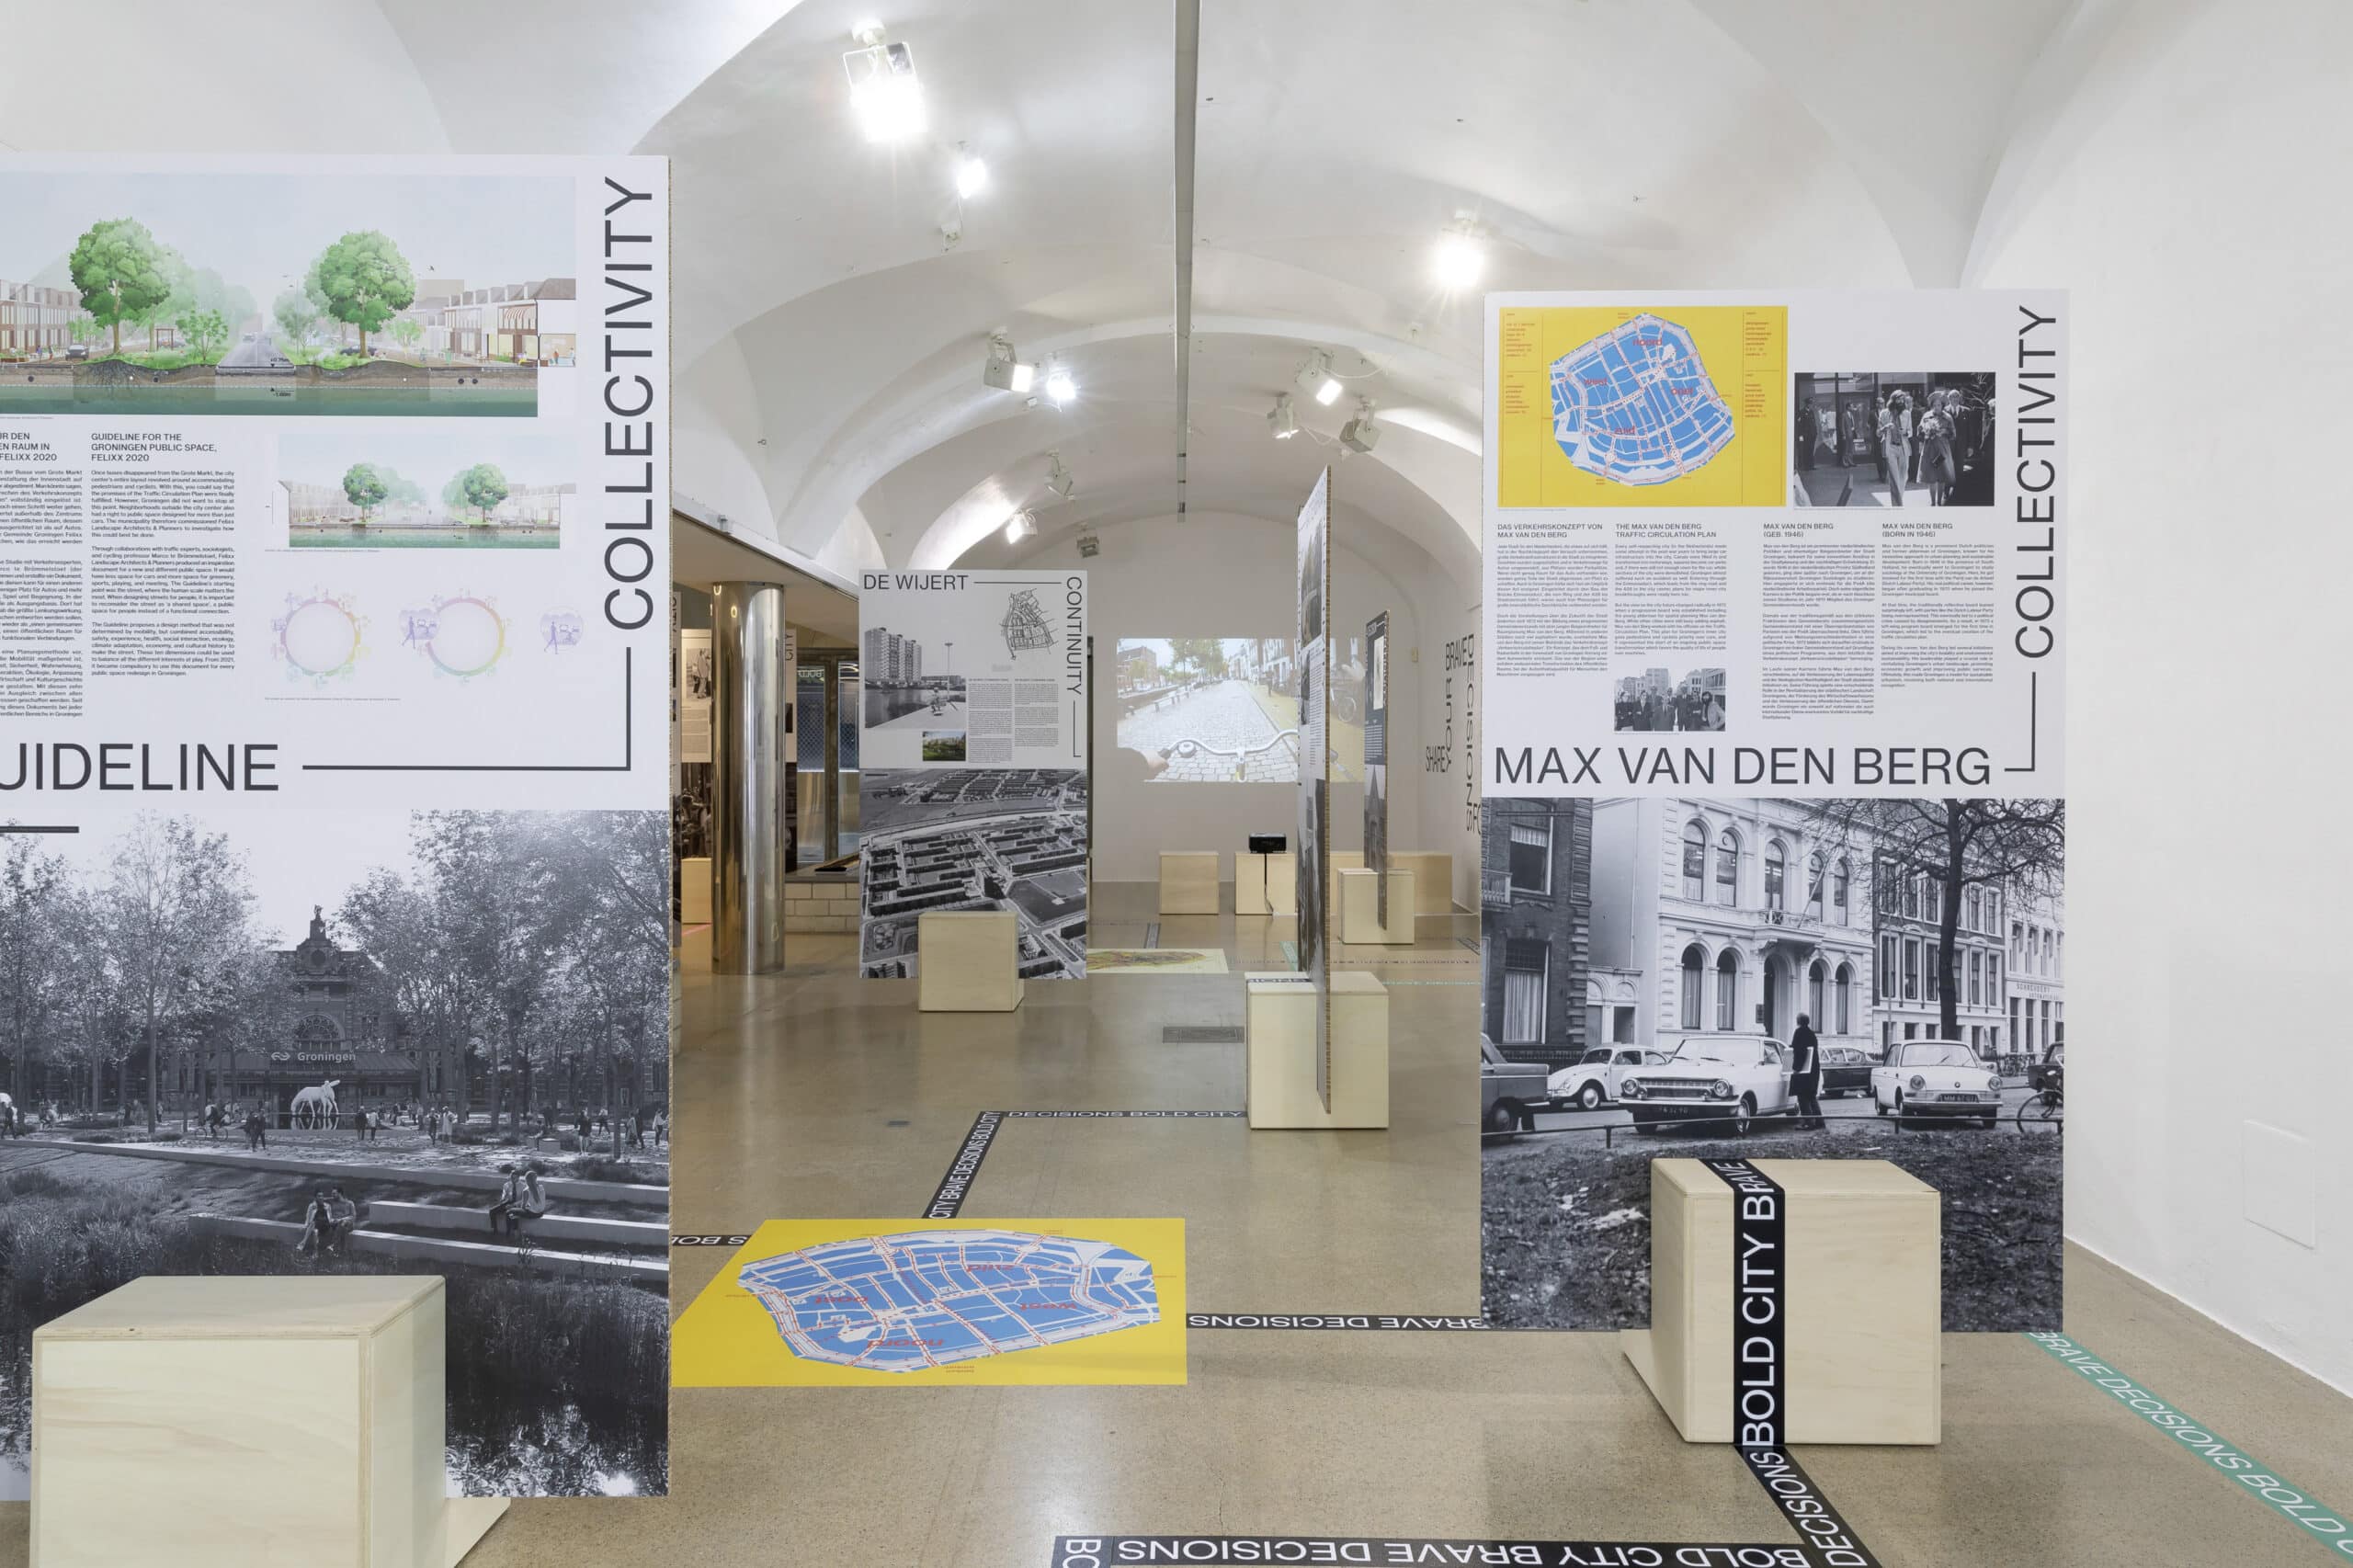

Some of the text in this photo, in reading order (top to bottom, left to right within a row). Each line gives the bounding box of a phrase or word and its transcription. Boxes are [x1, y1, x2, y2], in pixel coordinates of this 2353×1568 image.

[1632, 336, 1663, 347] noord
[1584, 377, 1608, 386] west
[1671, 387, 1693, 396] oost
[604, 176, 654, 631] COLLECTIVITY
[91, 433, 182, 441] GUIDELINE FOR THE
[1614, 426, 1636, 435] zuid
[0, 453, 58, 461] FELIXX 2020
[91, 443, 217, 452] GRONINGEN PUBLIC SPACE,
[91, 453, 150, 462] FELIXX 2020
[2015, 305, 2056, 658] COLLECTIVITY
[864, 574, 969, 590] DE WIJERT
[1066, 576, 1083, 695] CONTINUITY
[1446, 637, 1468, 671] BRAVE
[1466, 633, 1474, 832] DECISIONS
[1496, 747, 1990, 785] MAX VAN DEN BERG
[297, 1051, 357, 1063] Groningen
[928, 1111, 1001, 1219] CITY BRAVE DECISIONS BOLD CITY
[1712, 1162, 1775, 1446] BOLD CITY BRAVE
[1188, 1314, 1370, 1328] DECISIONS
[2096, 1378, 2253, 1470] DECISIONS
[2237, 1474, 2347, 1534] BOLD
[1749, 1451, 1868, 1568] DECISIONS
[1118, 1540, 1811, 1568] BOLD CITY BRAVE DECISIONS
